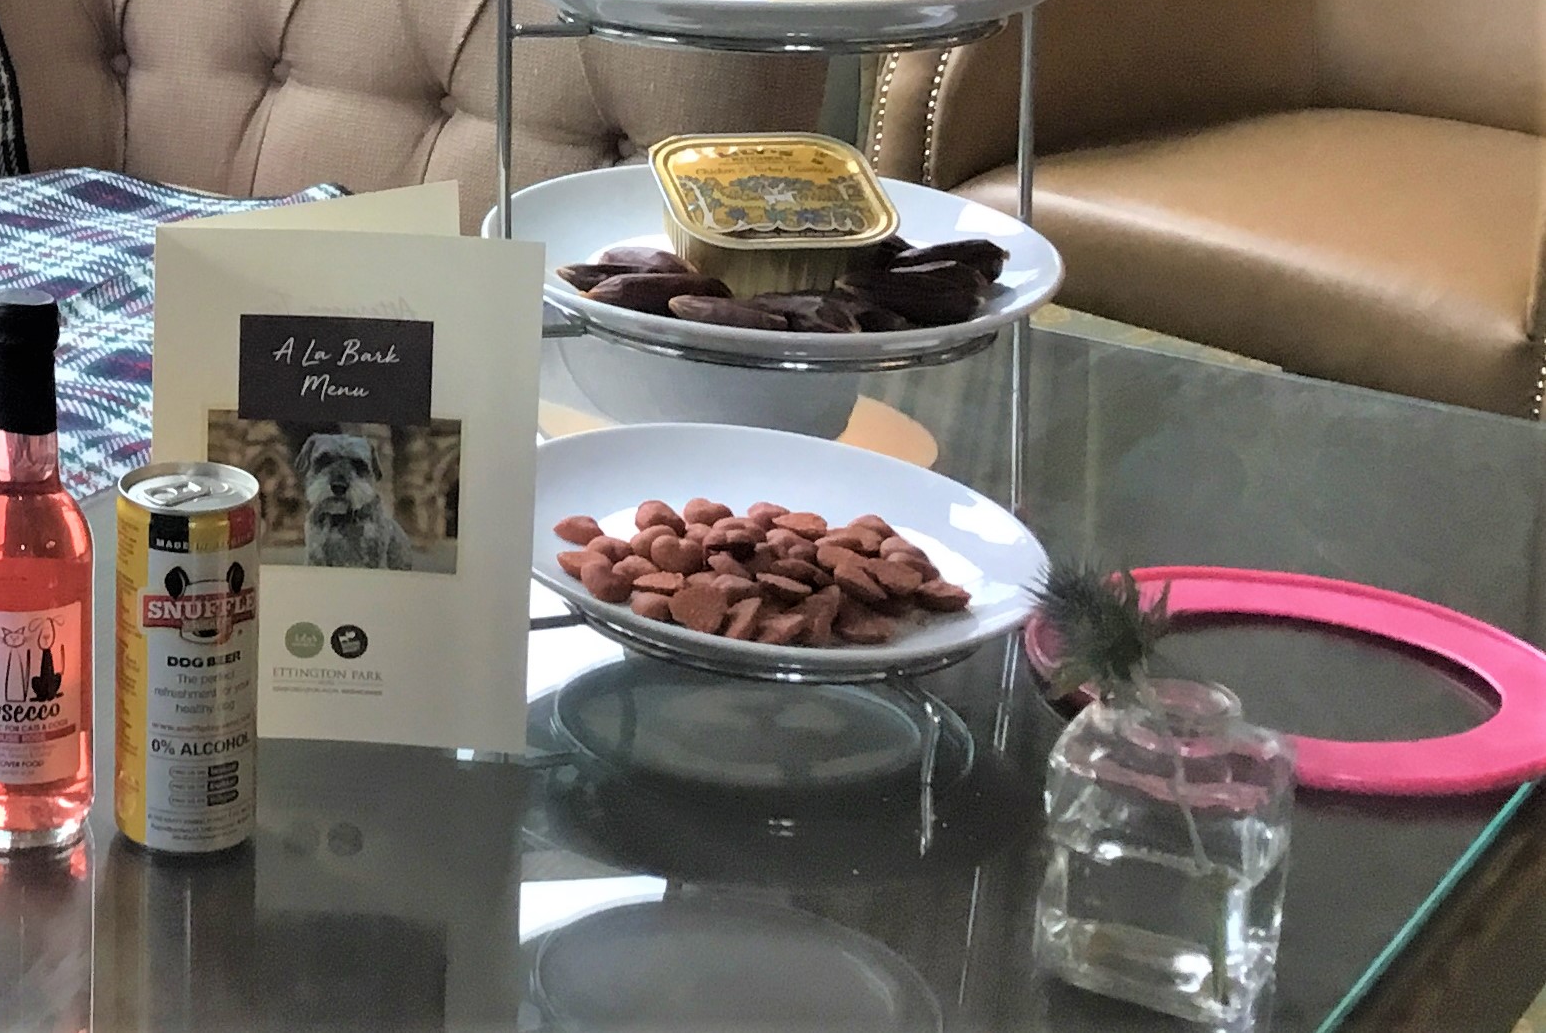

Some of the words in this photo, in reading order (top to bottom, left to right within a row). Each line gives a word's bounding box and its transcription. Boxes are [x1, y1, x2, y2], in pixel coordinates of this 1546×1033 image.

[272, 336, 295, 365] A
[302, 338, 332, 367] La
[336, 338, 400, 366] Bark
[300, 373, 370, 402] Menu
[167, 656, 204, 667] DOG
[272, 667, 347, 680] ETTINGTON
[352, 670, 383, 682] PARK
[151, 738, 175, 755] 0%
[180, 731, 251, 756] ALCOHOL
